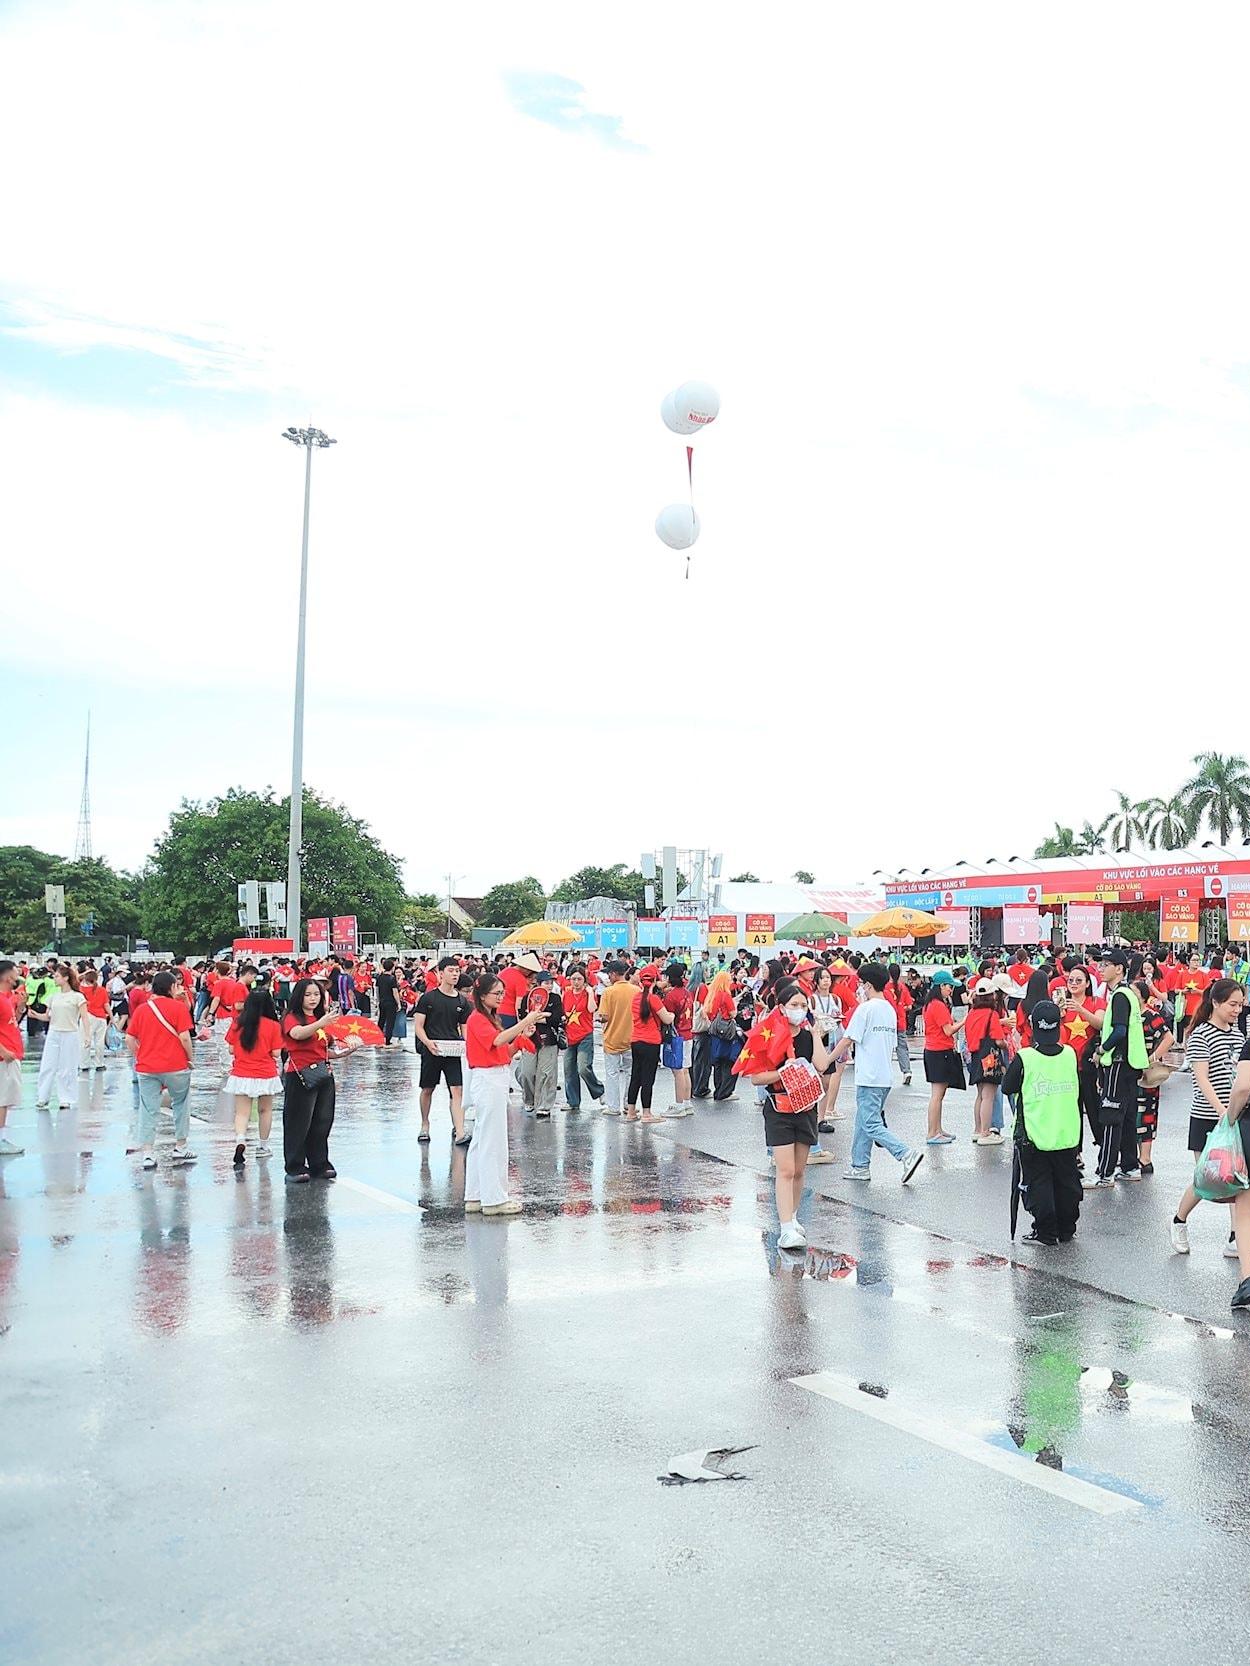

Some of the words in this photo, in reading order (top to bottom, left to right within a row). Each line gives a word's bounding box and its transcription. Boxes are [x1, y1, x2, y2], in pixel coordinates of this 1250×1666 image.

[1103, 871, 1118, 880] KHU
[1119, 870, 1135, 881] VỰC
[1136, 868, 1148, 878] LỐI
[1149, 867, 1165, 877] VÀO
[1167, 866, 1182, 876] CÁC
[1184, 866, 1206, 877] HẠNG
[1208, 863, 1219, 874] VÉ
[1177, 890, 1188, 898] B3
[1018, 926, 1026, 936] 3
[1171, 926, 1188, 938] A2
[611, 934, 616, 942] 2
[718, 935, 728, 944] A1
[753, 935, 766, 943] A3
